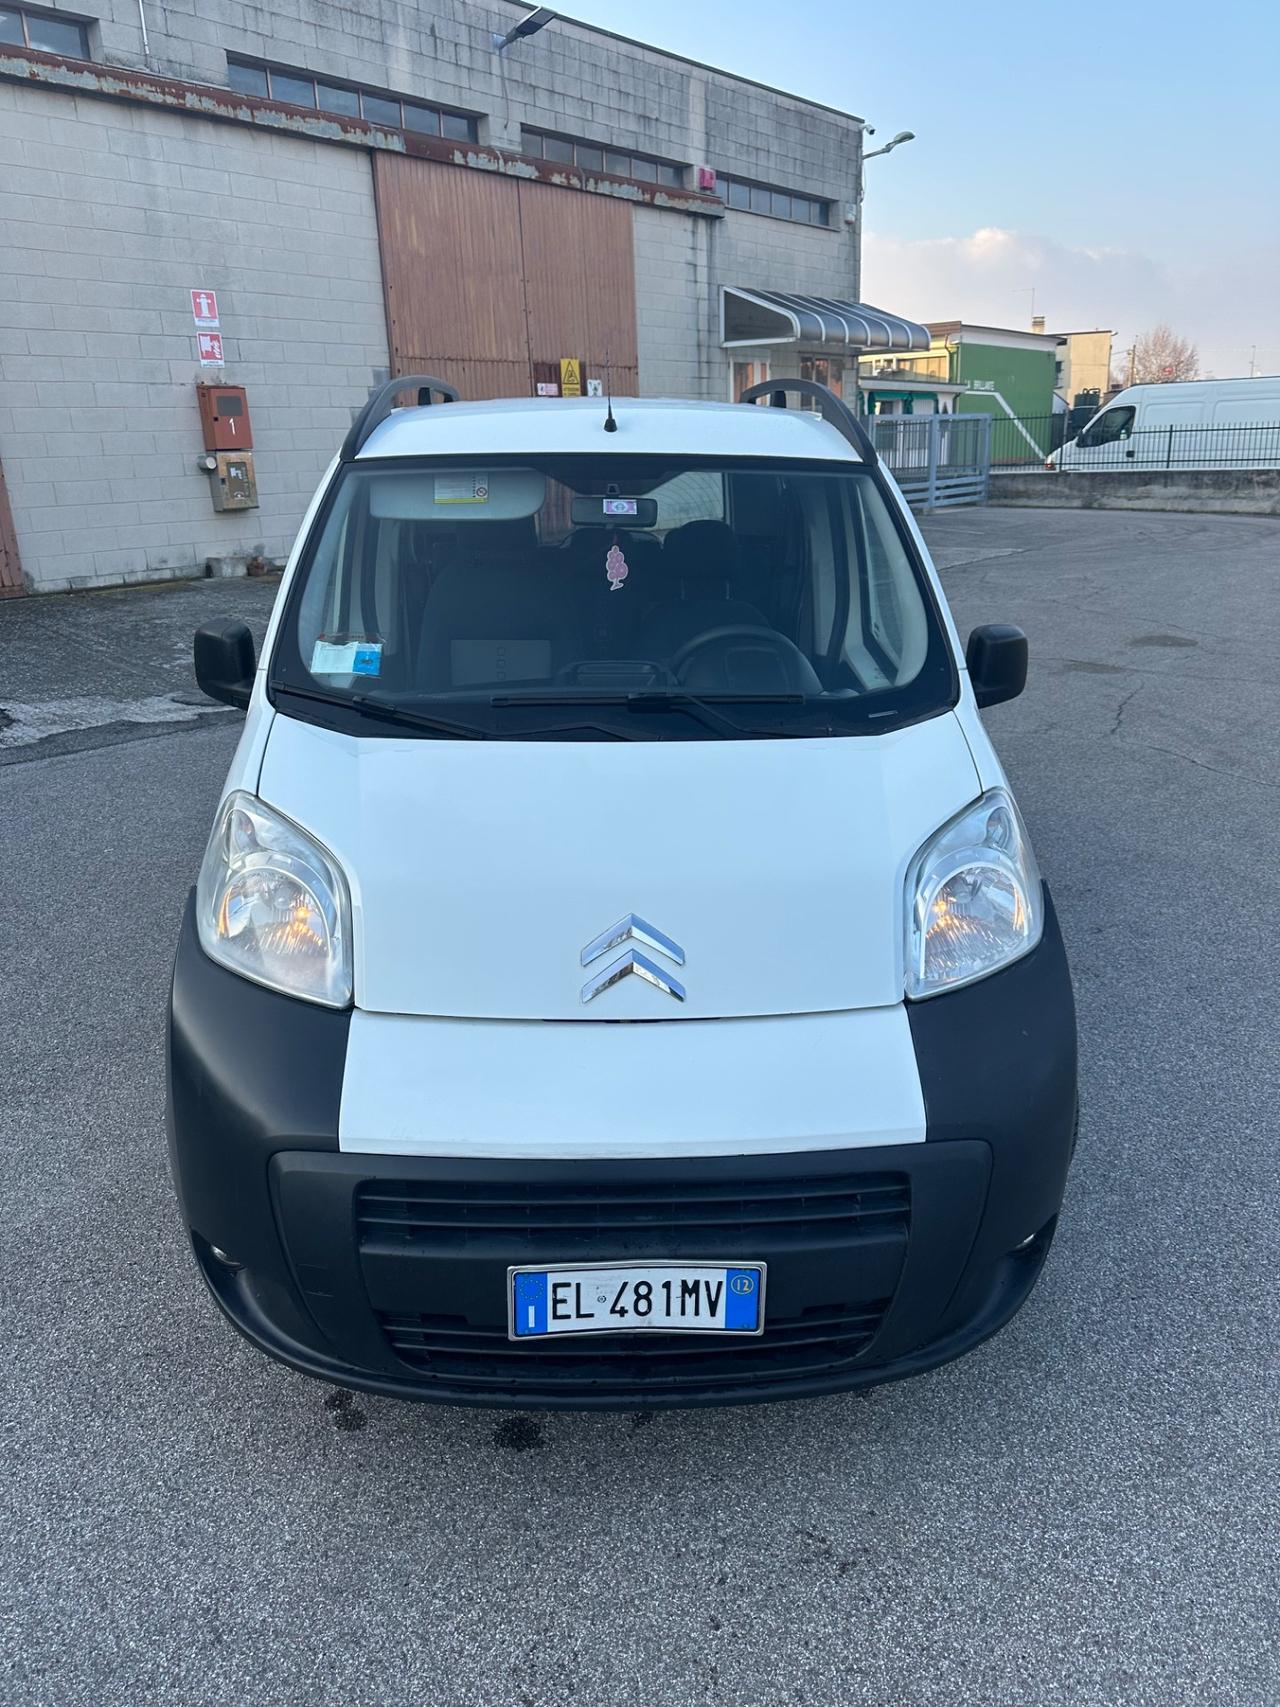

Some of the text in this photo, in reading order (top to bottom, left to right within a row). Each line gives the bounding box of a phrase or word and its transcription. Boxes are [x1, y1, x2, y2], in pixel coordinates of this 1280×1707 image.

[229, 418, 236, 435] 1
[735, 1279, 750, 1292] 12
[551, 1279, 723, 1320] EL 481MV
[528, 1305, 535, 1328] I
